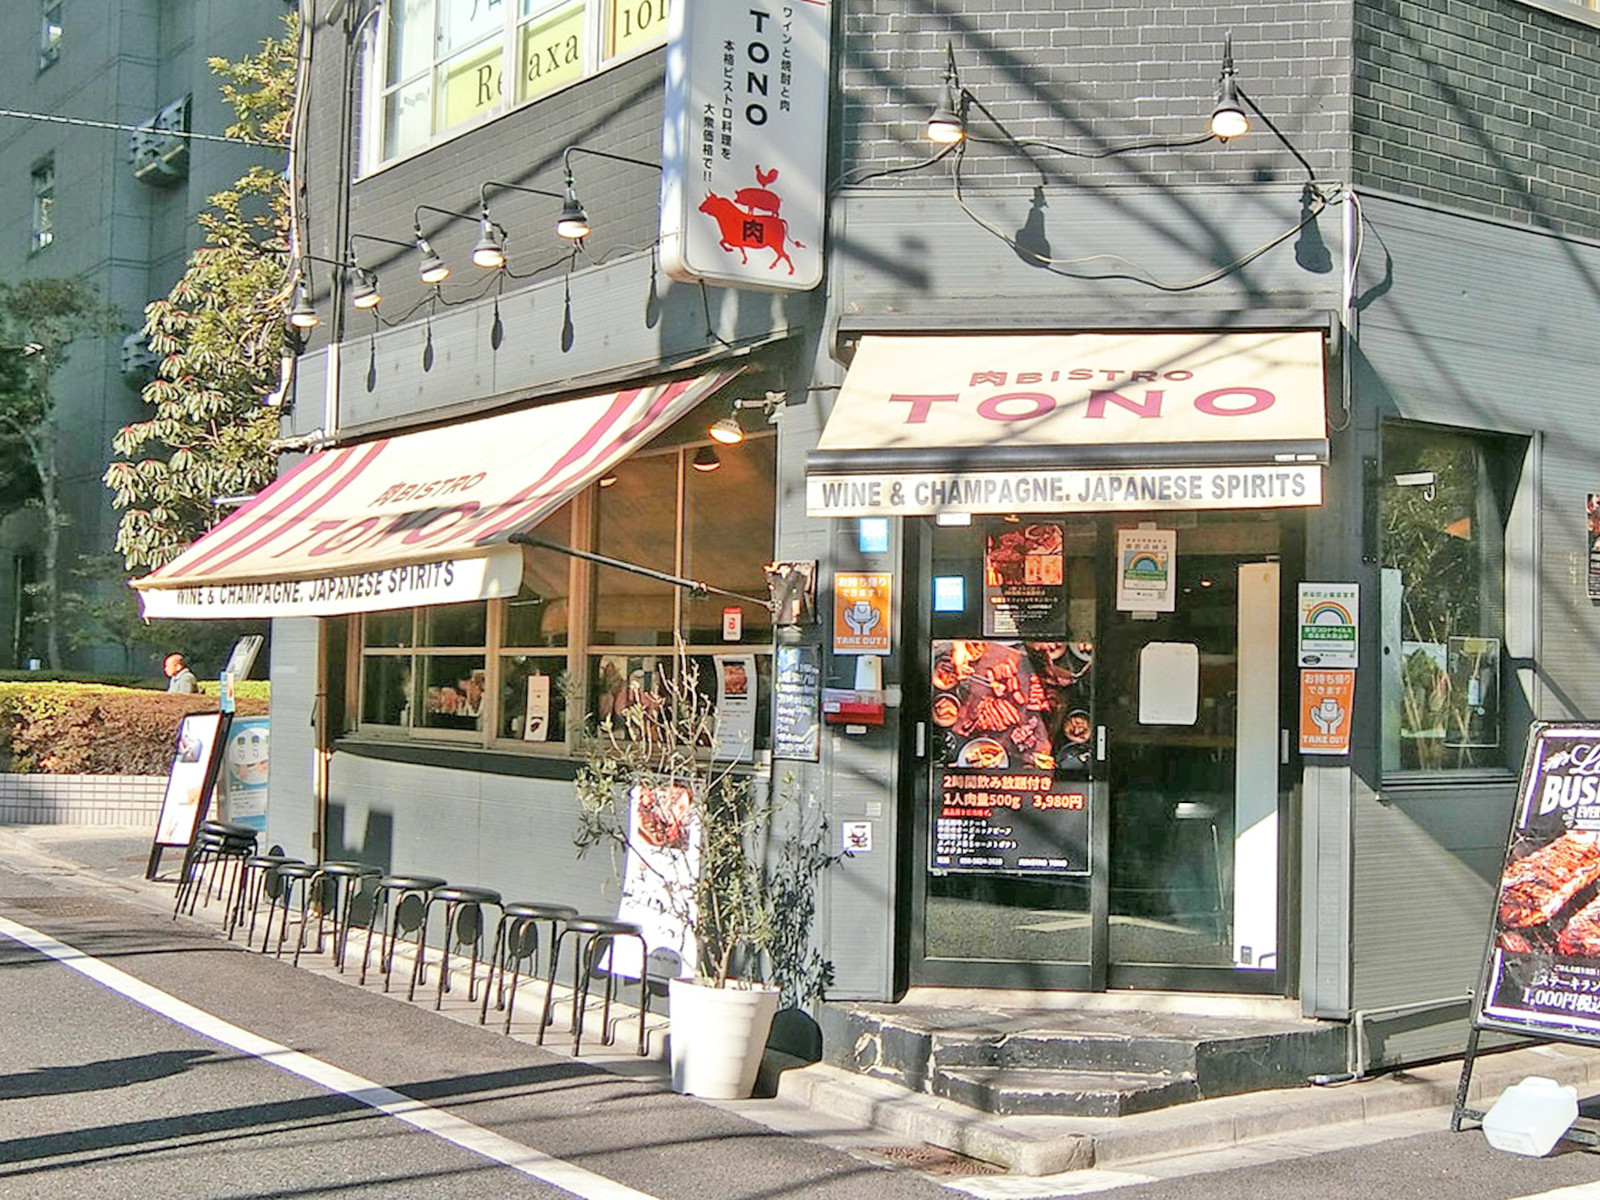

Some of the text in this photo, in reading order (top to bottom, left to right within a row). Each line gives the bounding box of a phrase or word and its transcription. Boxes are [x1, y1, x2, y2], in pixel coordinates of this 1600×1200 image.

[745, 9, 770, 126] TONO
[780, 6, 793, 112] ワインと焼酎と肉
[721, 39, 735, 160] 本格ビストロ料理を
[742, 219, 764, 243] 肉
[888, 386, 1276, 424] TONO
[822, 480, 882, 508] WINE
[889, 481, 906, 506] &
[1078, 474, 1203, 503] JAPANESE
[1211, 472, 1307, 500] SPIRITS
[271, 501, 481, 558] TONO
[177, 586, 204, 605] WINE
[207, 586, 215, 605] &
[309, 571, 383, 602] JAPANESE
[387, 559, 455, 593] SPIRITS
[836, 636, 860, 645] TAKE
[1303, 735, 1328, 745] TAKE
[942, 775, 1053, 791] 2時間飲み放題付き
[1032, 795, 1084, 810] 3,980円
